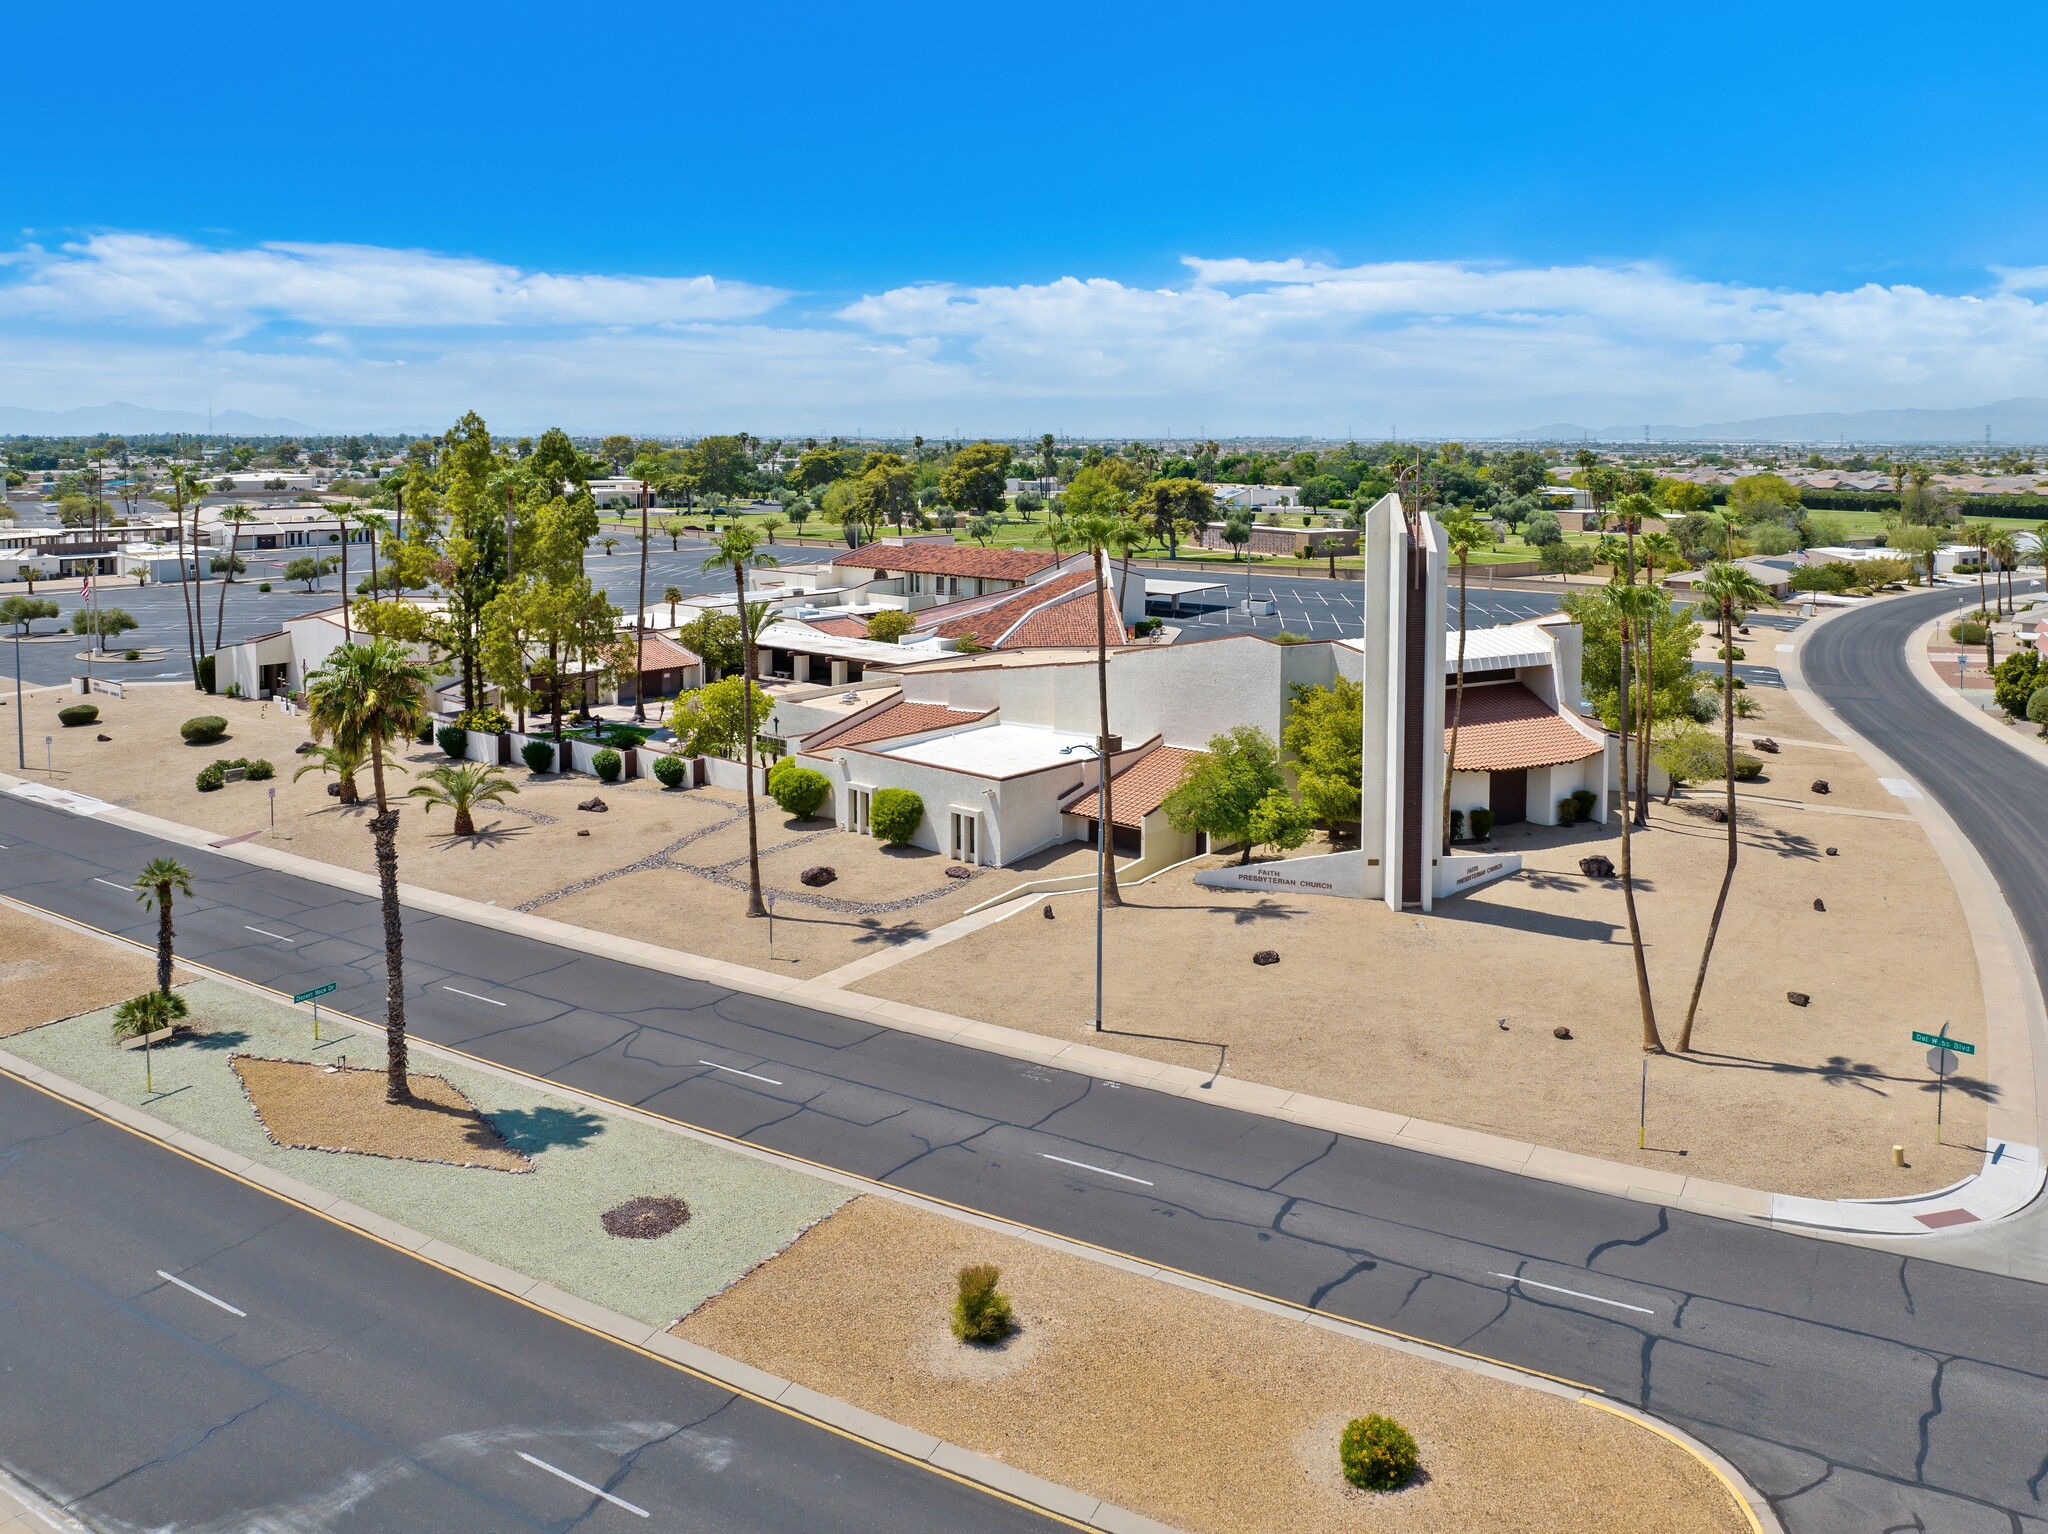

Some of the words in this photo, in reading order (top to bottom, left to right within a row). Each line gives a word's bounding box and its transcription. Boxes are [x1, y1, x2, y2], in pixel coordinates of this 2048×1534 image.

[1238, 874, 1296, 886] PRESBYTERIAN
[1300, 880, 1333, 890] CHURCH
[1916, 1033, 1928, 1042] Del
[1931, 1038, 1950, 1047] Wbb
[1953, 1043, 1970, 1052] Blvd
